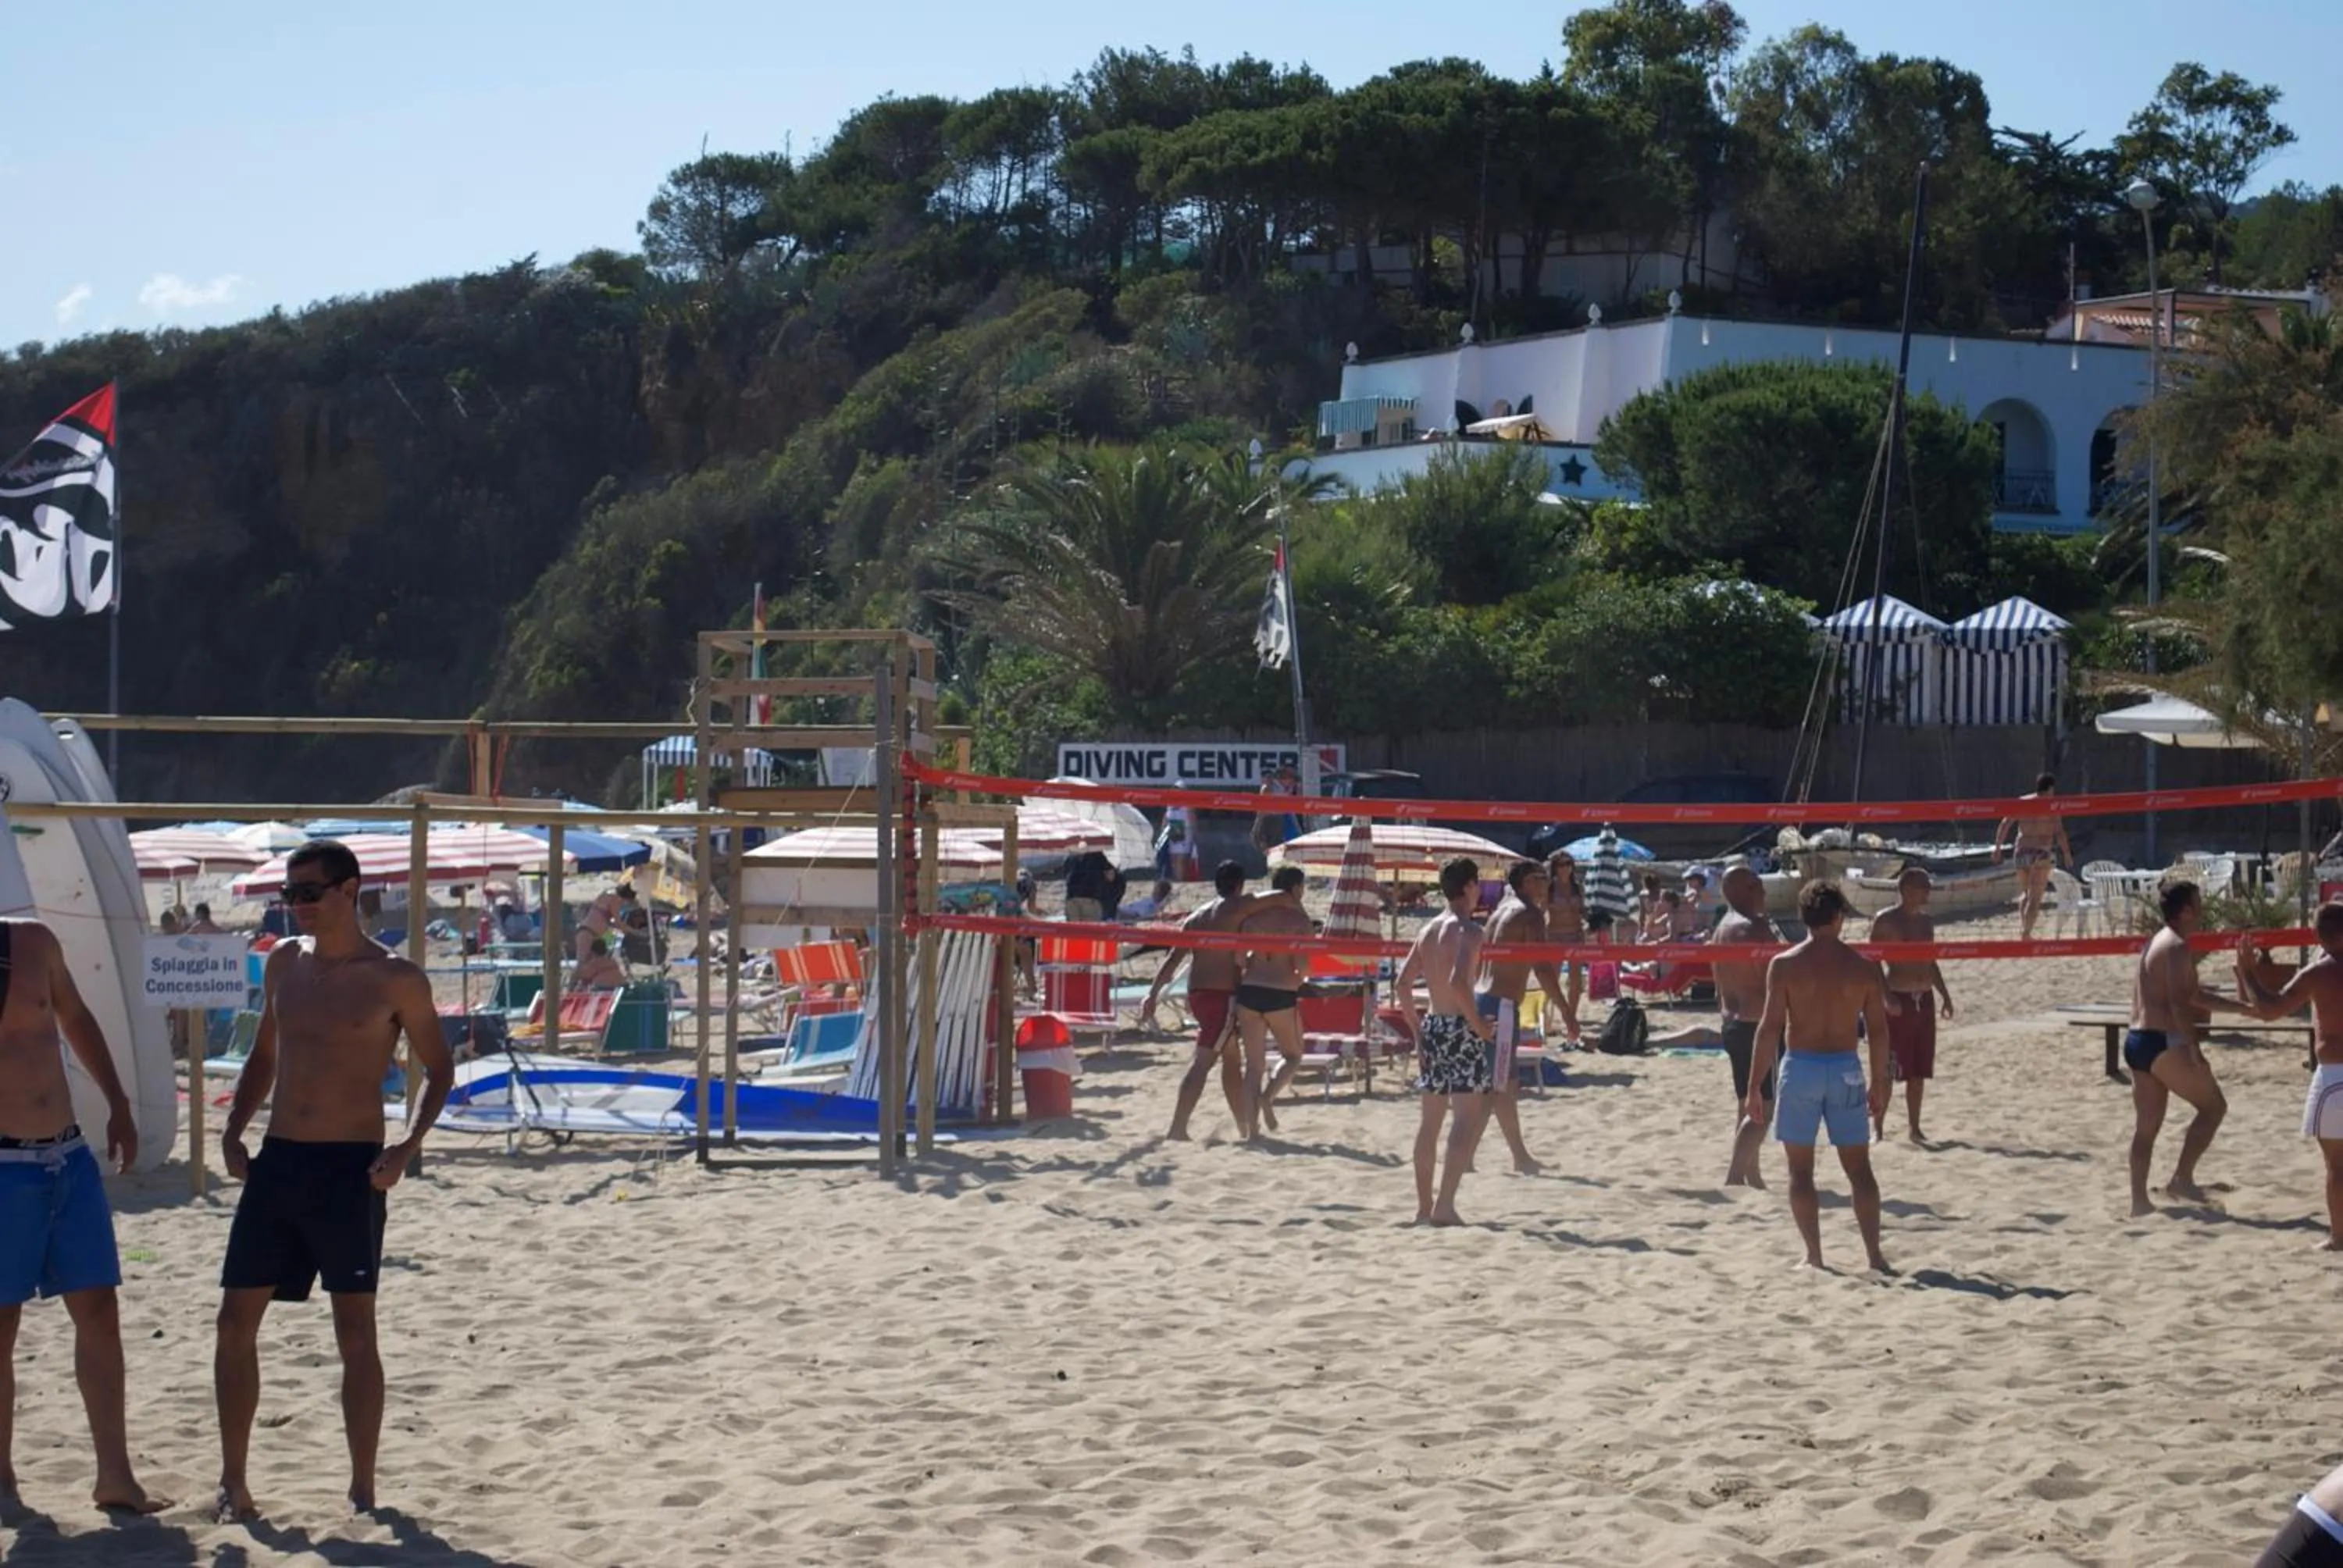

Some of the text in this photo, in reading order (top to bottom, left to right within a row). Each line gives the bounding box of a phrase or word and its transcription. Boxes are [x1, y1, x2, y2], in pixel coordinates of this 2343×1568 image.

[1064, 750, 1166, 779] DIVING
[152, 957, 237, 975] Spiaggia in
[146, 978, 243, 993] Concessione
